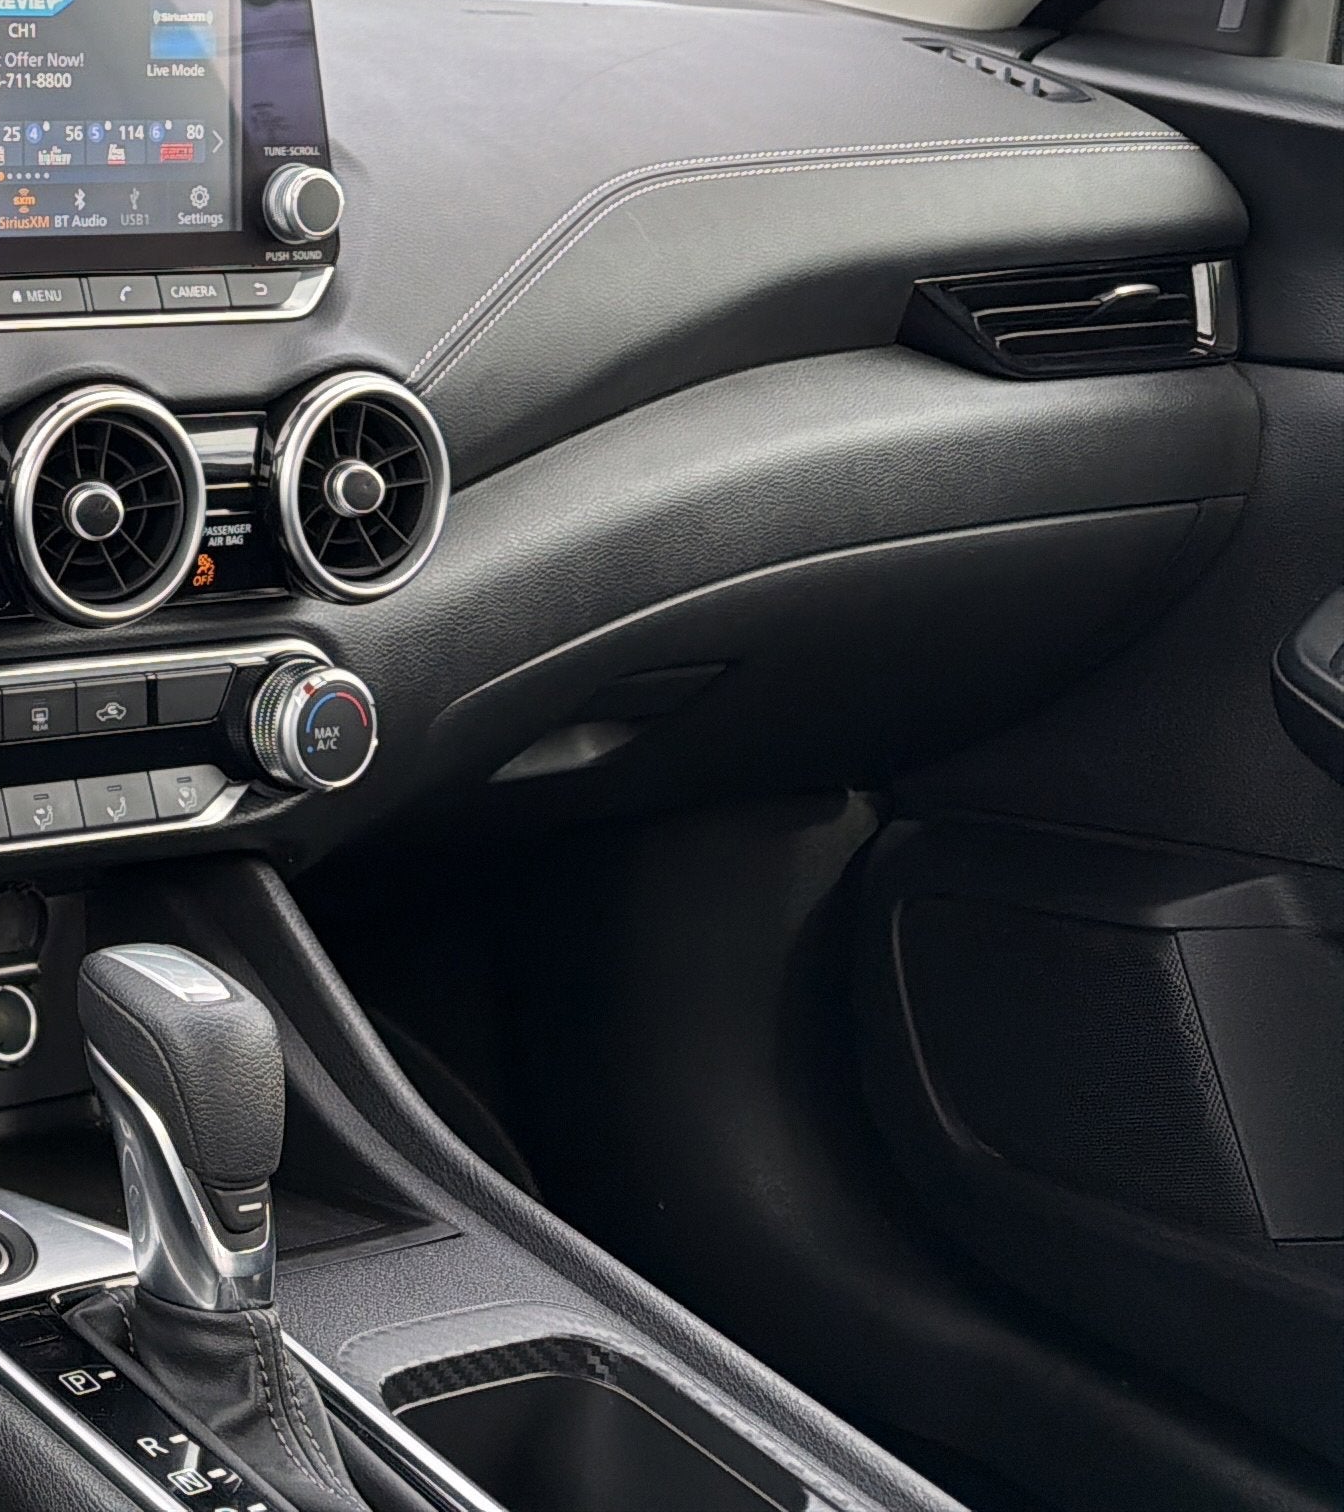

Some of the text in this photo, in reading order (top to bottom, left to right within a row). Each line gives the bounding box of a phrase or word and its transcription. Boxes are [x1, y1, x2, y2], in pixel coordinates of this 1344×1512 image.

[8, 23, 36, 39] CH1
[5, 51, 44, 68] Offer
[47, 51, 85, 68] Now!
[147, 63, 206, 77] Live Mode
[2, 126, 21, 142] 25
[29, 125, 84, 141] 4 56
[92, 125, 145, 141] 5 114
[152, 124, 205, 140] 6 80
[0, 215, 50, 230] SiriusXM
[54, 214, 108, 228] BT Audio
[120, 213, 150, 226] USB1
[177, 212, 224, 228] Settings
[265, 249, 323, 262] PUSH SOUND
[25, 289, 62, 302] MENU
[170, 285, 217, 299] CAMERA
[202, 523, 252, 537] PASSENGER
[208, 534, 244, 547] AIR BAG
[192, 574, 214, 587] OFF
[314, 725, 340, 740] MAX
[316, 738, 339, 751] A/C
[67, 1374, 86, 1391] P
[137, 1437, 169, 1457] R
[174, 1472, 202, 1491] N
